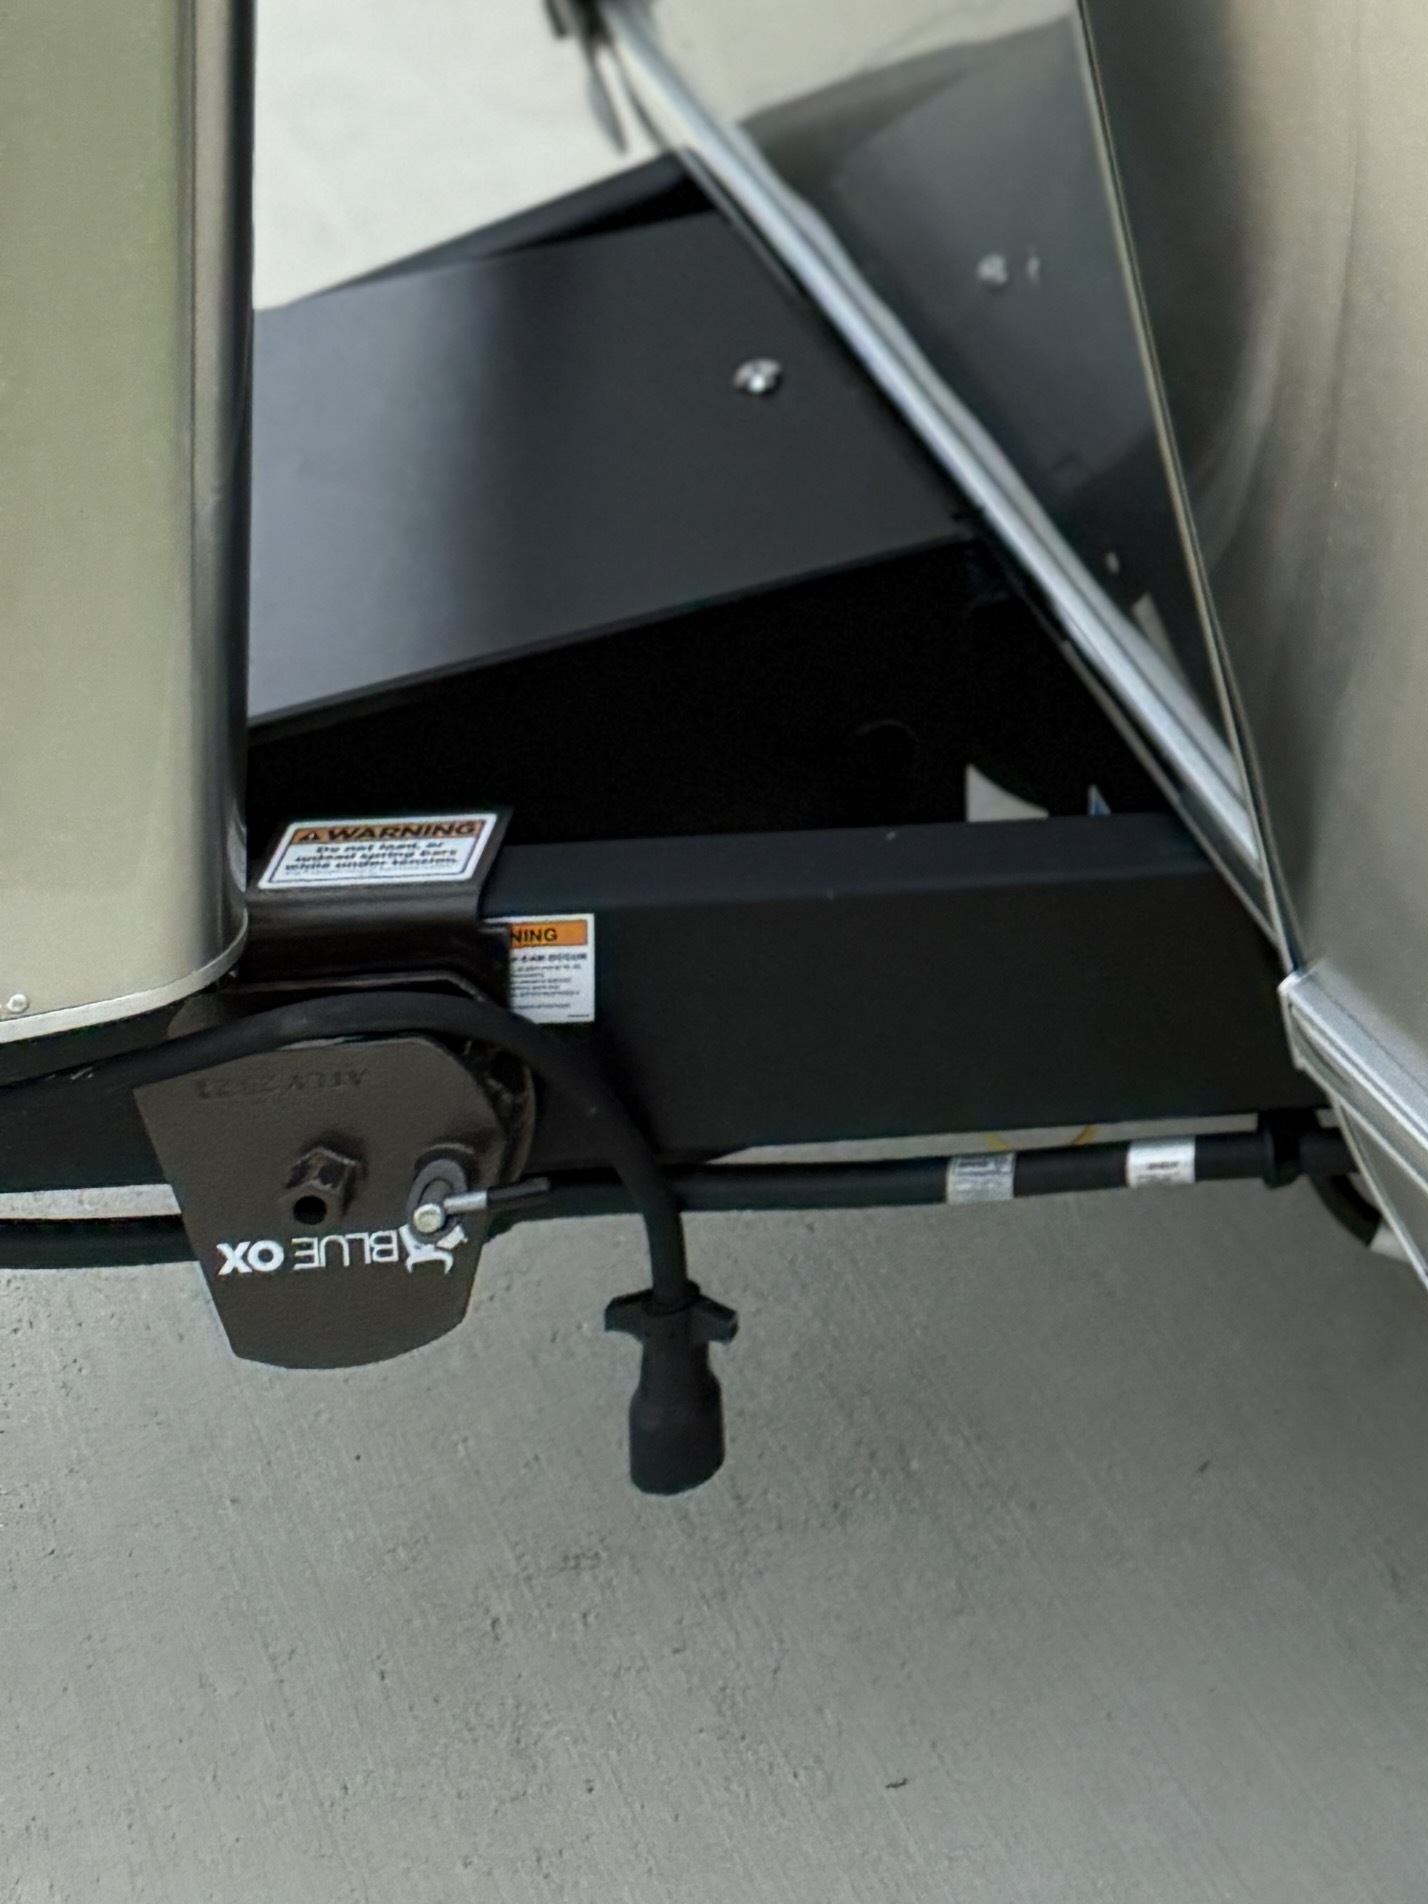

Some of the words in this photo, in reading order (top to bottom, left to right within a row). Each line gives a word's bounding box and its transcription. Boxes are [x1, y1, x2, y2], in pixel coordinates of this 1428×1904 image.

[327, 820, 476, 841] WARNING
[510, 927, 558, 943] NING
[216, 1239, 285, 1276] OX
[291, 1229, 400, 1271] BLUE
